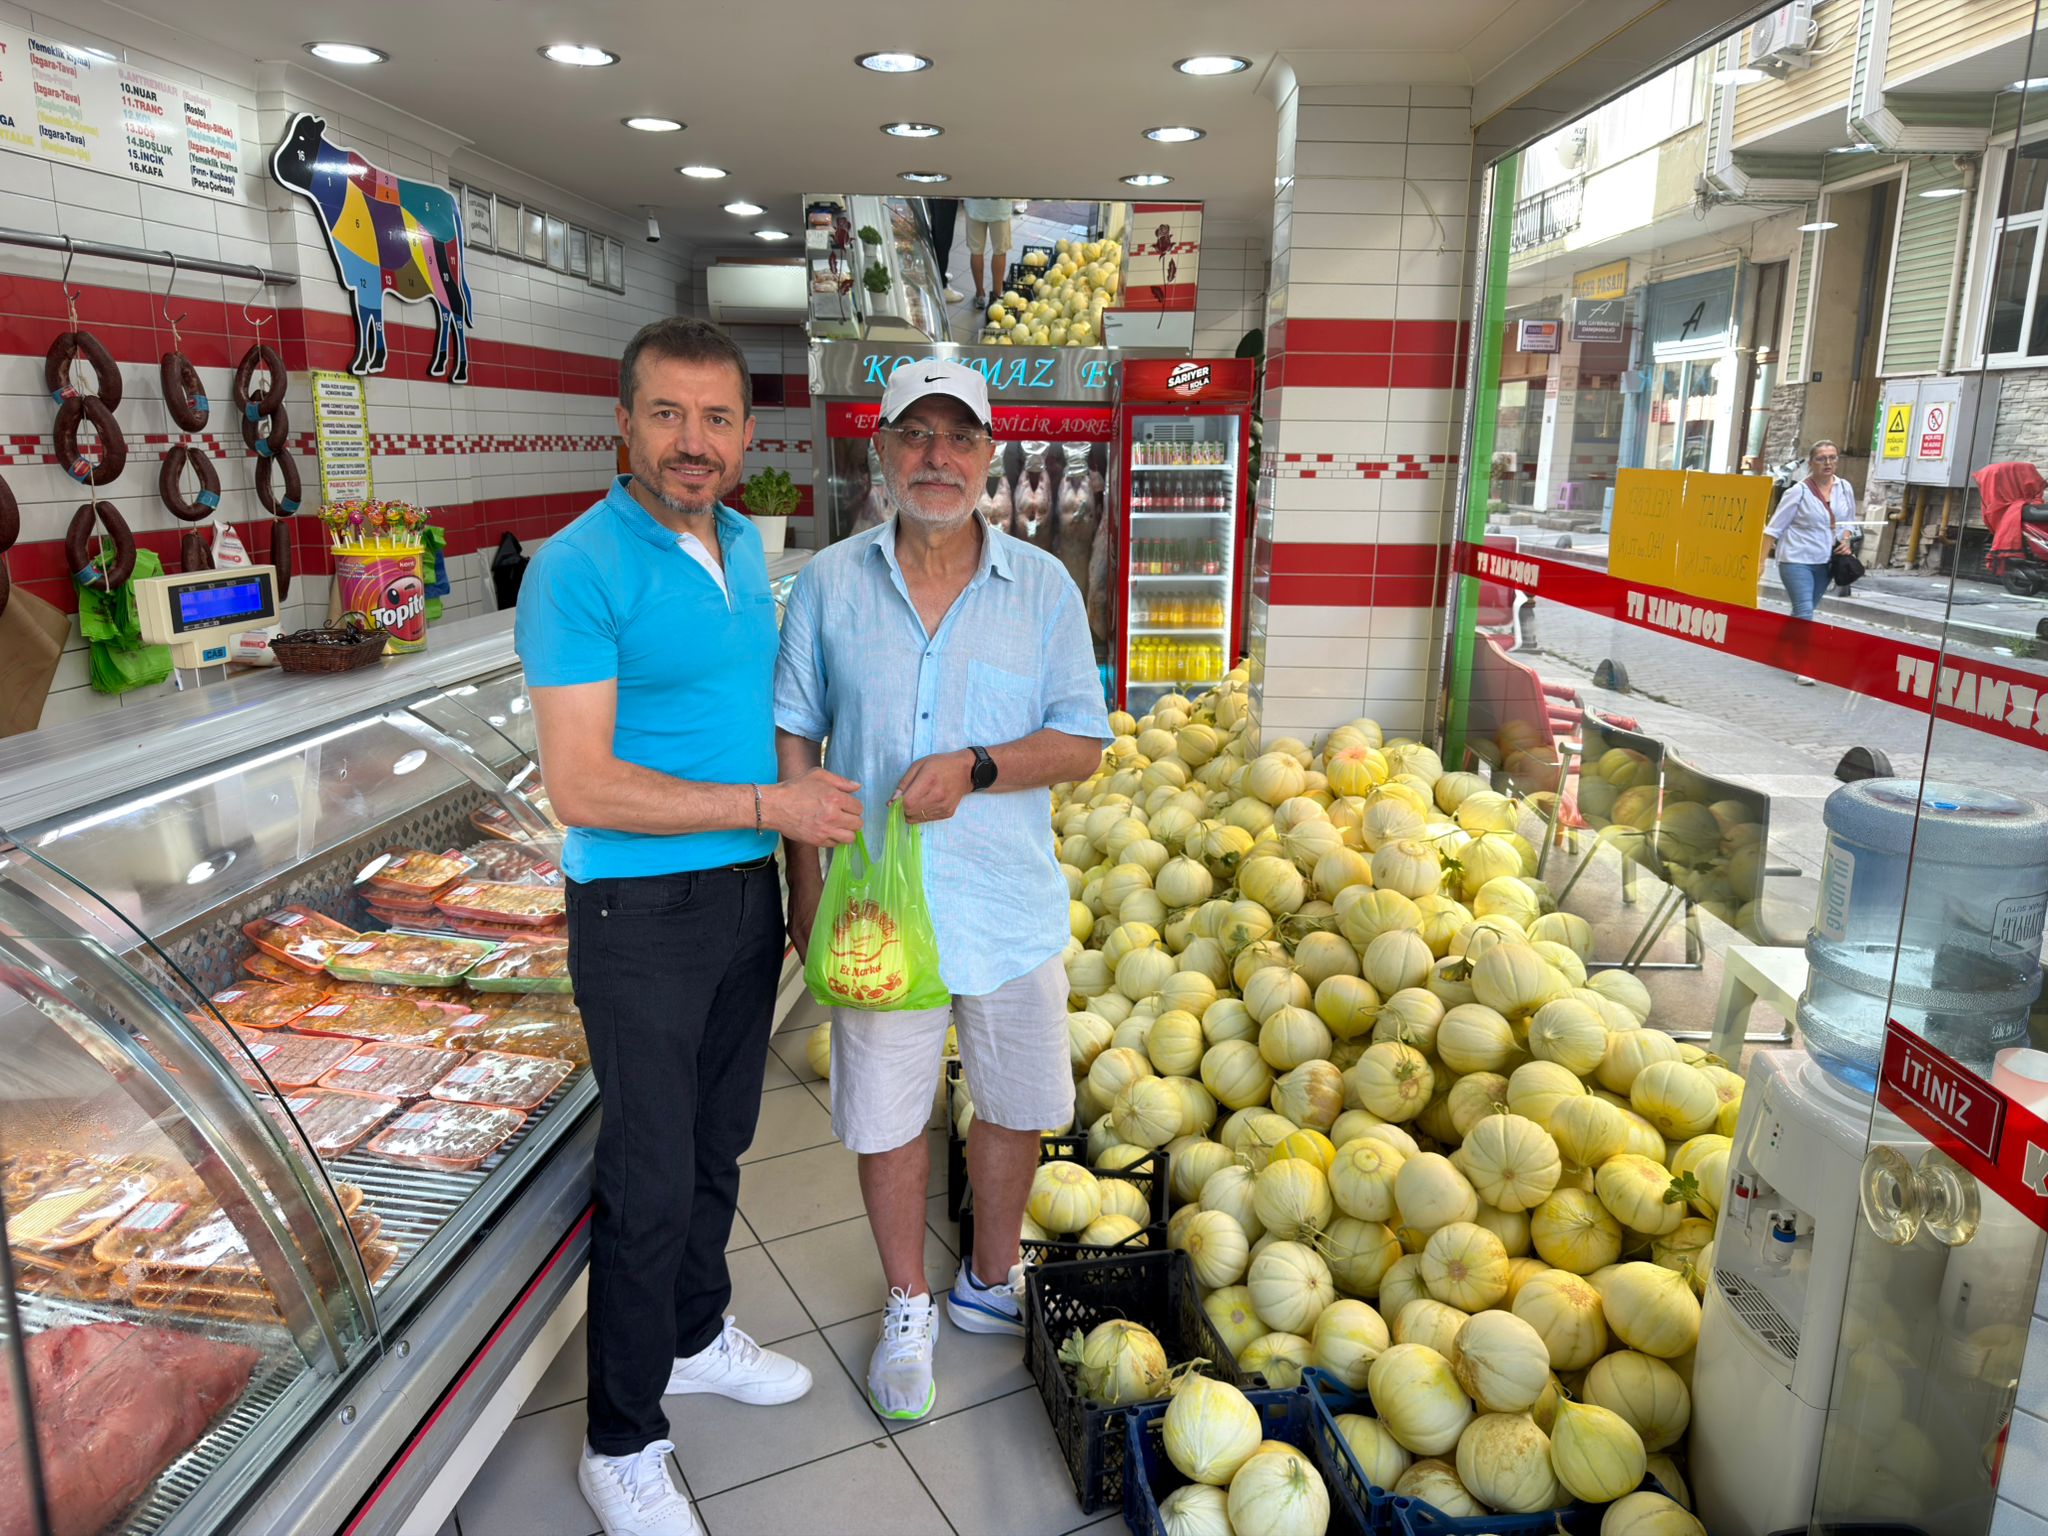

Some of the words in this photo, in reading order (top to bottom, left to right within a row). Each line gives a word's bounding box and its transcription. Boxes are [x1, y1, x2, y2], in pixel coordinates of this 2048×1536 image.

[120, 82, 158, 102] 10.NUAR
[126, 135, 174, 157] 14.BOŞLUK
[128, 148, 165, 167] 15.İNCİK
[297, 150, 305, 162] 16
[129, 161, 164, 178] 16.KAFA
[355, 219, 360, 229] 6
[360, 278, 367, 288] 12
[385, 276, 392, 285] 13
[1680, 301, 1705, 342] A
[863, 354, 1055, 390] KMAZ
[1167, 366, 1210, 388] SARIYER
[1189, 377, 1210, 390] KOLA
[1055, 418, 1110, 436] ADRE
[206, 648, 224, 660] CAS
[1827, 857, 1850, 932] ULUDAĞ
[1901, 1048, 1973, 1128] İTİNİZ
